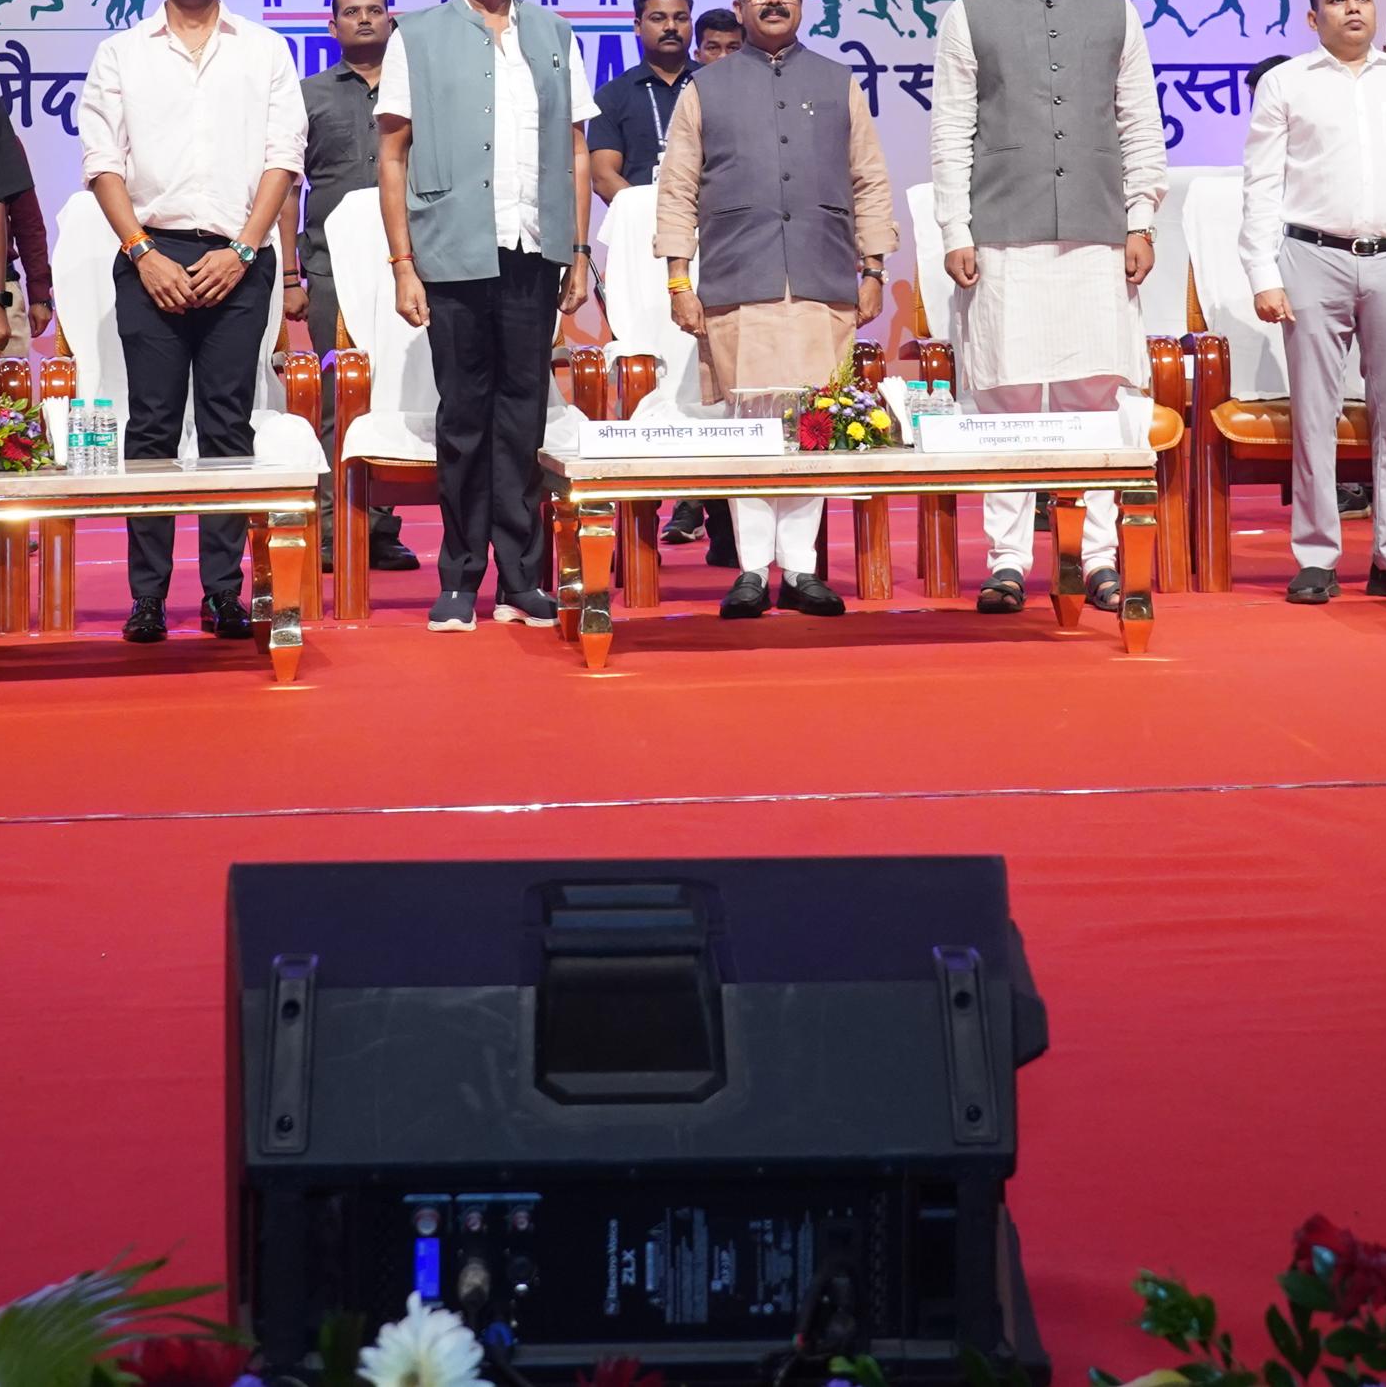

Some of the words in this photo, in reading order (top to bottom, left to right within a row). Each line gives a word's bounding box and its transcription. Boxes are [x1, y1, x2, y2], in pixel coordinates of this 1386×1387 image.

[598, 425, 636, 438] श्रीमान
[698, 426, 744, 438] अग्रवाल
[749, 423, 764, 437] जी
[622, 1247, 637, 1286] ZLX
